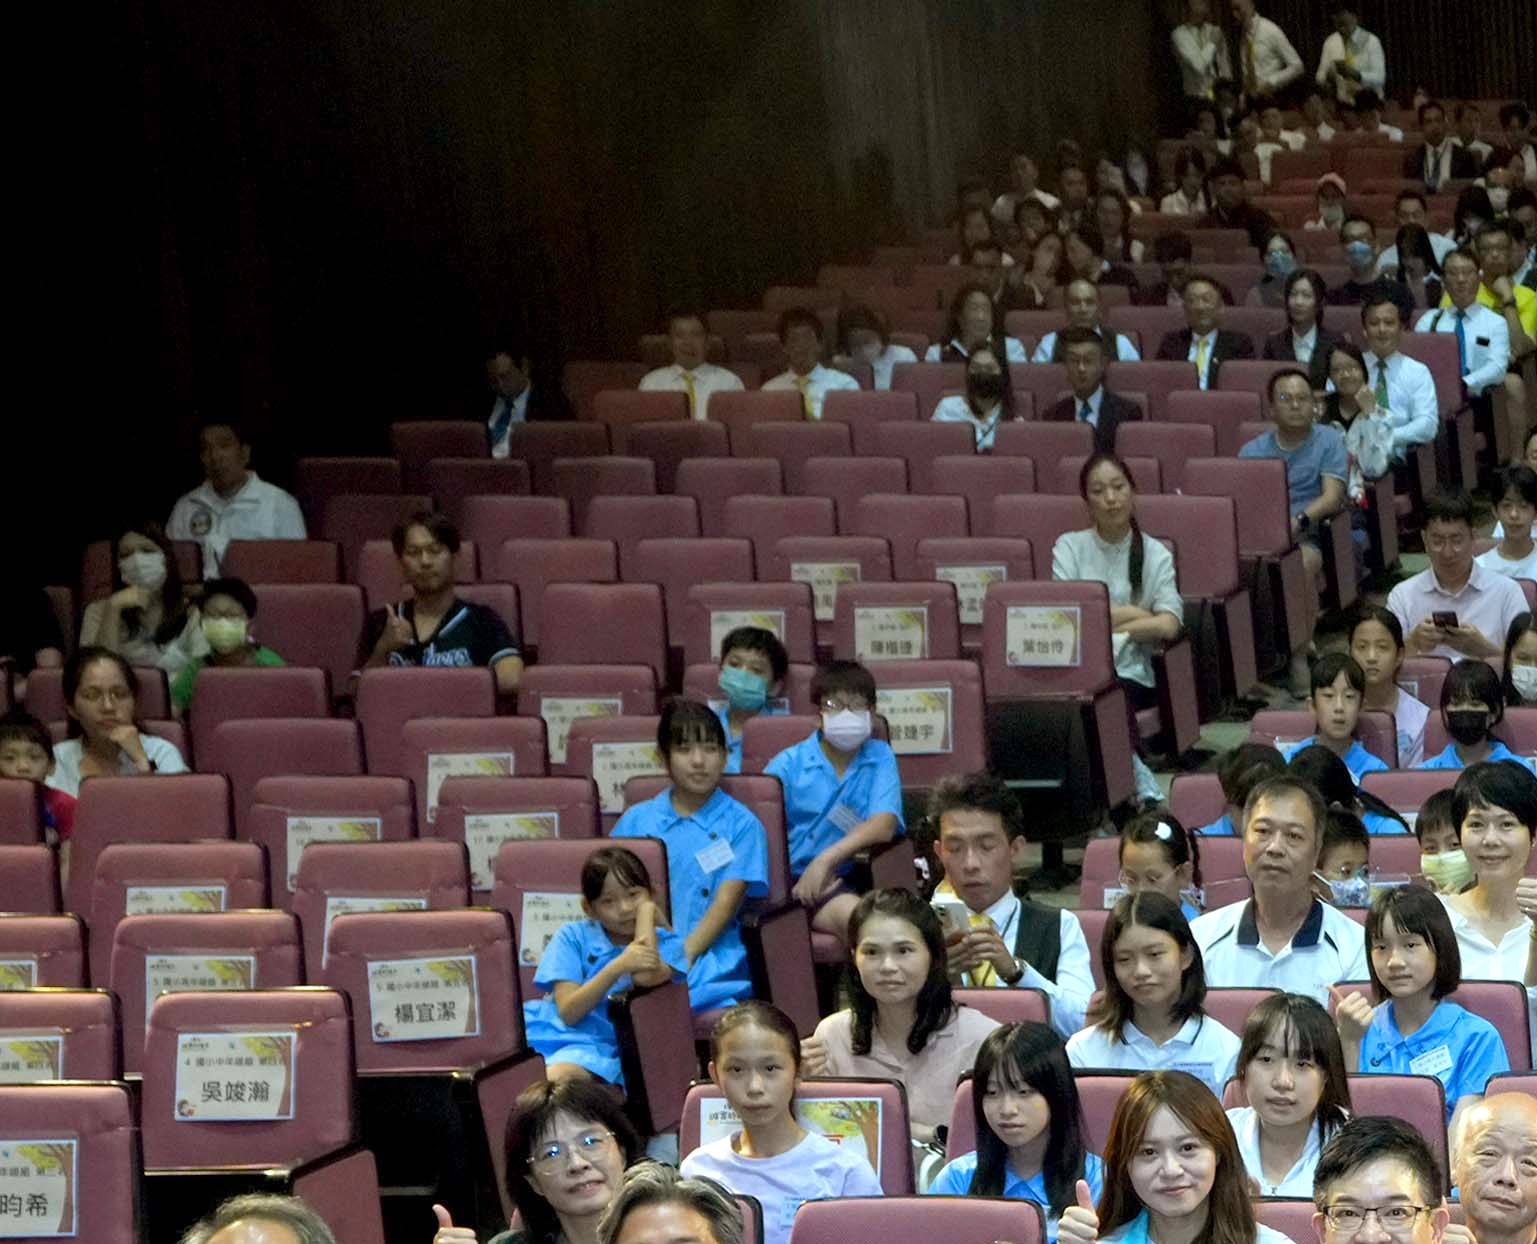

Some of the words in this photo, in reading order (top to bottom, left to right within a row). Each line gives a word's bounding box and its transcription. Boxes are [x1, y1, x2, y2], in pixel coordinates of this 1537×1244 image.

[394, 1001, 457, 1025] 楊宜潔
[202, 1080, 270, 1103] 吳竣瀚
